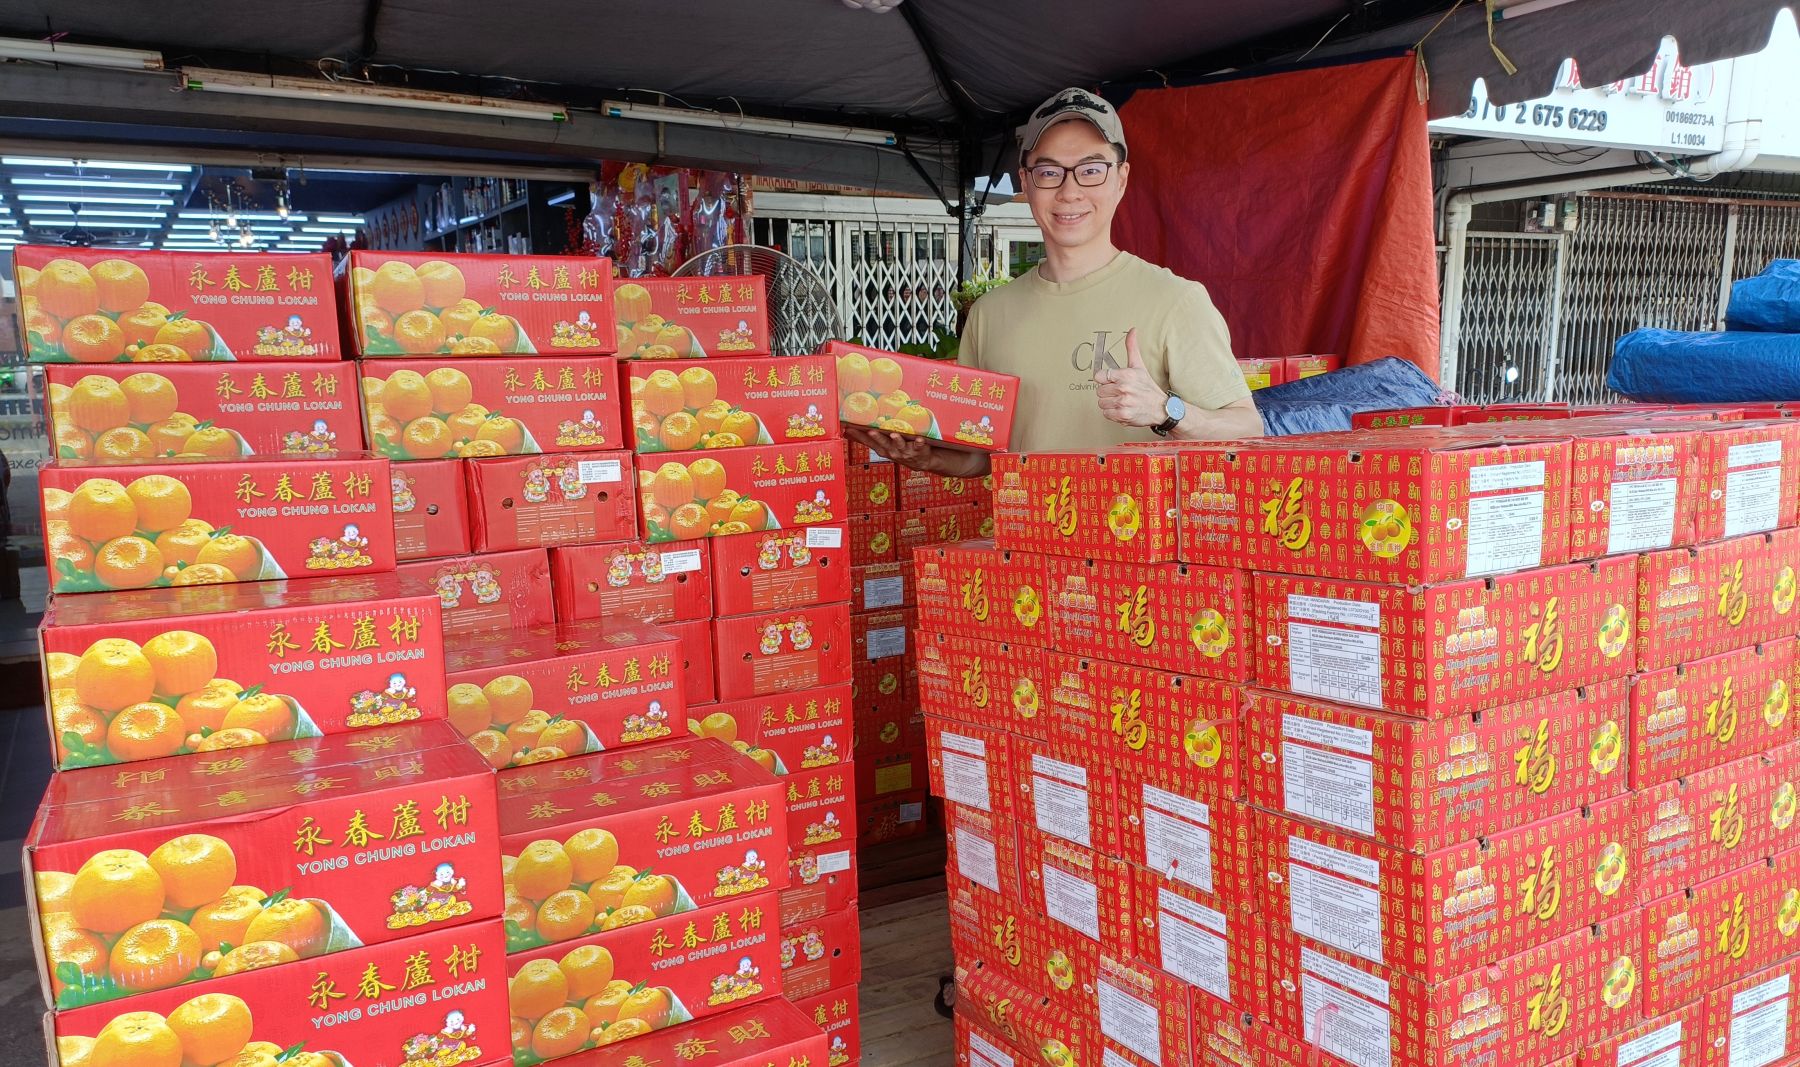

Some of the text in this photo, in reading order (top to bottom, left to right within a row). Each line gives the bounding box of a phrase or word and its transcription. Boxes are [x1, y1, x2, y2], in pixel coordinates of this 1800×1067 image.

[1532, 104, 1564, 127] 675
[1568, 108, 1607, 132] 6229
[1665, 110, 1715, 126] 001869273-A
[1671, 132, 1706, 146] L1.10034
[189, 262, 314, 291] 永春蘆柑
[497, 263, 600, 290] 永春蘆柑
[191, 294, 318, 306] YONG CHUNG LOKAN
[500, 292, 603, 302] YONG CHUNG LOKAN
[676, 283, 754, 305] 永春蘆柑
[678, 306, 700, 314] YONG
[732, 305, 757, 313] LOKAN
[216, 372, 338, 399] 永春蘆柑
[503, 367, 604, 391] 永春蘆柑
[743, 365, 825, 388] 永春蘆柑
[1069, 383, 1092, 391] Calvin
[219, 400, 342, 413] YONG CHUNG LOKAN
[505, 393, 607, 404] YONG CHUNG LOKAN
[744, 388, 827, 399] YONG CHUNG LOKAN
[926, 390, 1004, 412] YONG CHUNG LOKAN
[752, 451, 832, 476] 永春蘆柑
[234, 471, 373, 503] 永春蘆柑
[753, 473, 835, 488] YONG CHUNG LOKAN
[237, 503, 376, 518] YONG CHUNG LOKAN
[1044, 475, 1077, 536] 福
[1262, 477, 1312, 550] 福
[962, 568, 990, 621] 福
[1718, 559, 1748, 626] 福
[1117, 585, 1156, 647] 福
[265, 614, 422, 658] 永春蘆柑
[1523, 597, 1564, 672] 福
[269, 648, 425, 675] YONG CHUNG LOKAN
[566, 655, 672, 692] 永春蘆柑
[568, 680, 674, 705] YONG CHUNG LOKAN
[962, 656, 989, 708] 福
[762, 698, 841, 726] 永春蘆柑
[1111, 687, 1148, 750] 福
[1705, 676, 1738, 743] 福
[763, 718, 843, 738] YONG CHUNG LOKAN
[1514, 718, 1556, 794] 福
[790, 795, 845, 812] CHUNG LOKAN
[1710, 783, 1744, 850] 福
[292, 794, 472, 857] 永春蘆柑
[655, 799, 770, 844] 永春蘆柑
[297, 833, 476, 876] YONG CHUNG LOKAN
[657, 826, 772, 859] YONG CHUNG LOKAN
[1521, 845, 1561, 920] 福
[650, 907, 763, 957] 永春蘆柑
[992, 912, 1021, 966] 福
[1719, 892, 1750, 960] 福
[651, 933, 766, 971] YONG CHUNG LOKAN
[308, 944, 482, 1010] 永春蘆柑
[311, 979, 486, 1029] YONG CHUNG LOKAN
[1527, 963, 1568, 1037] 福
[826, 1018, 851, 1033] LOKAN
